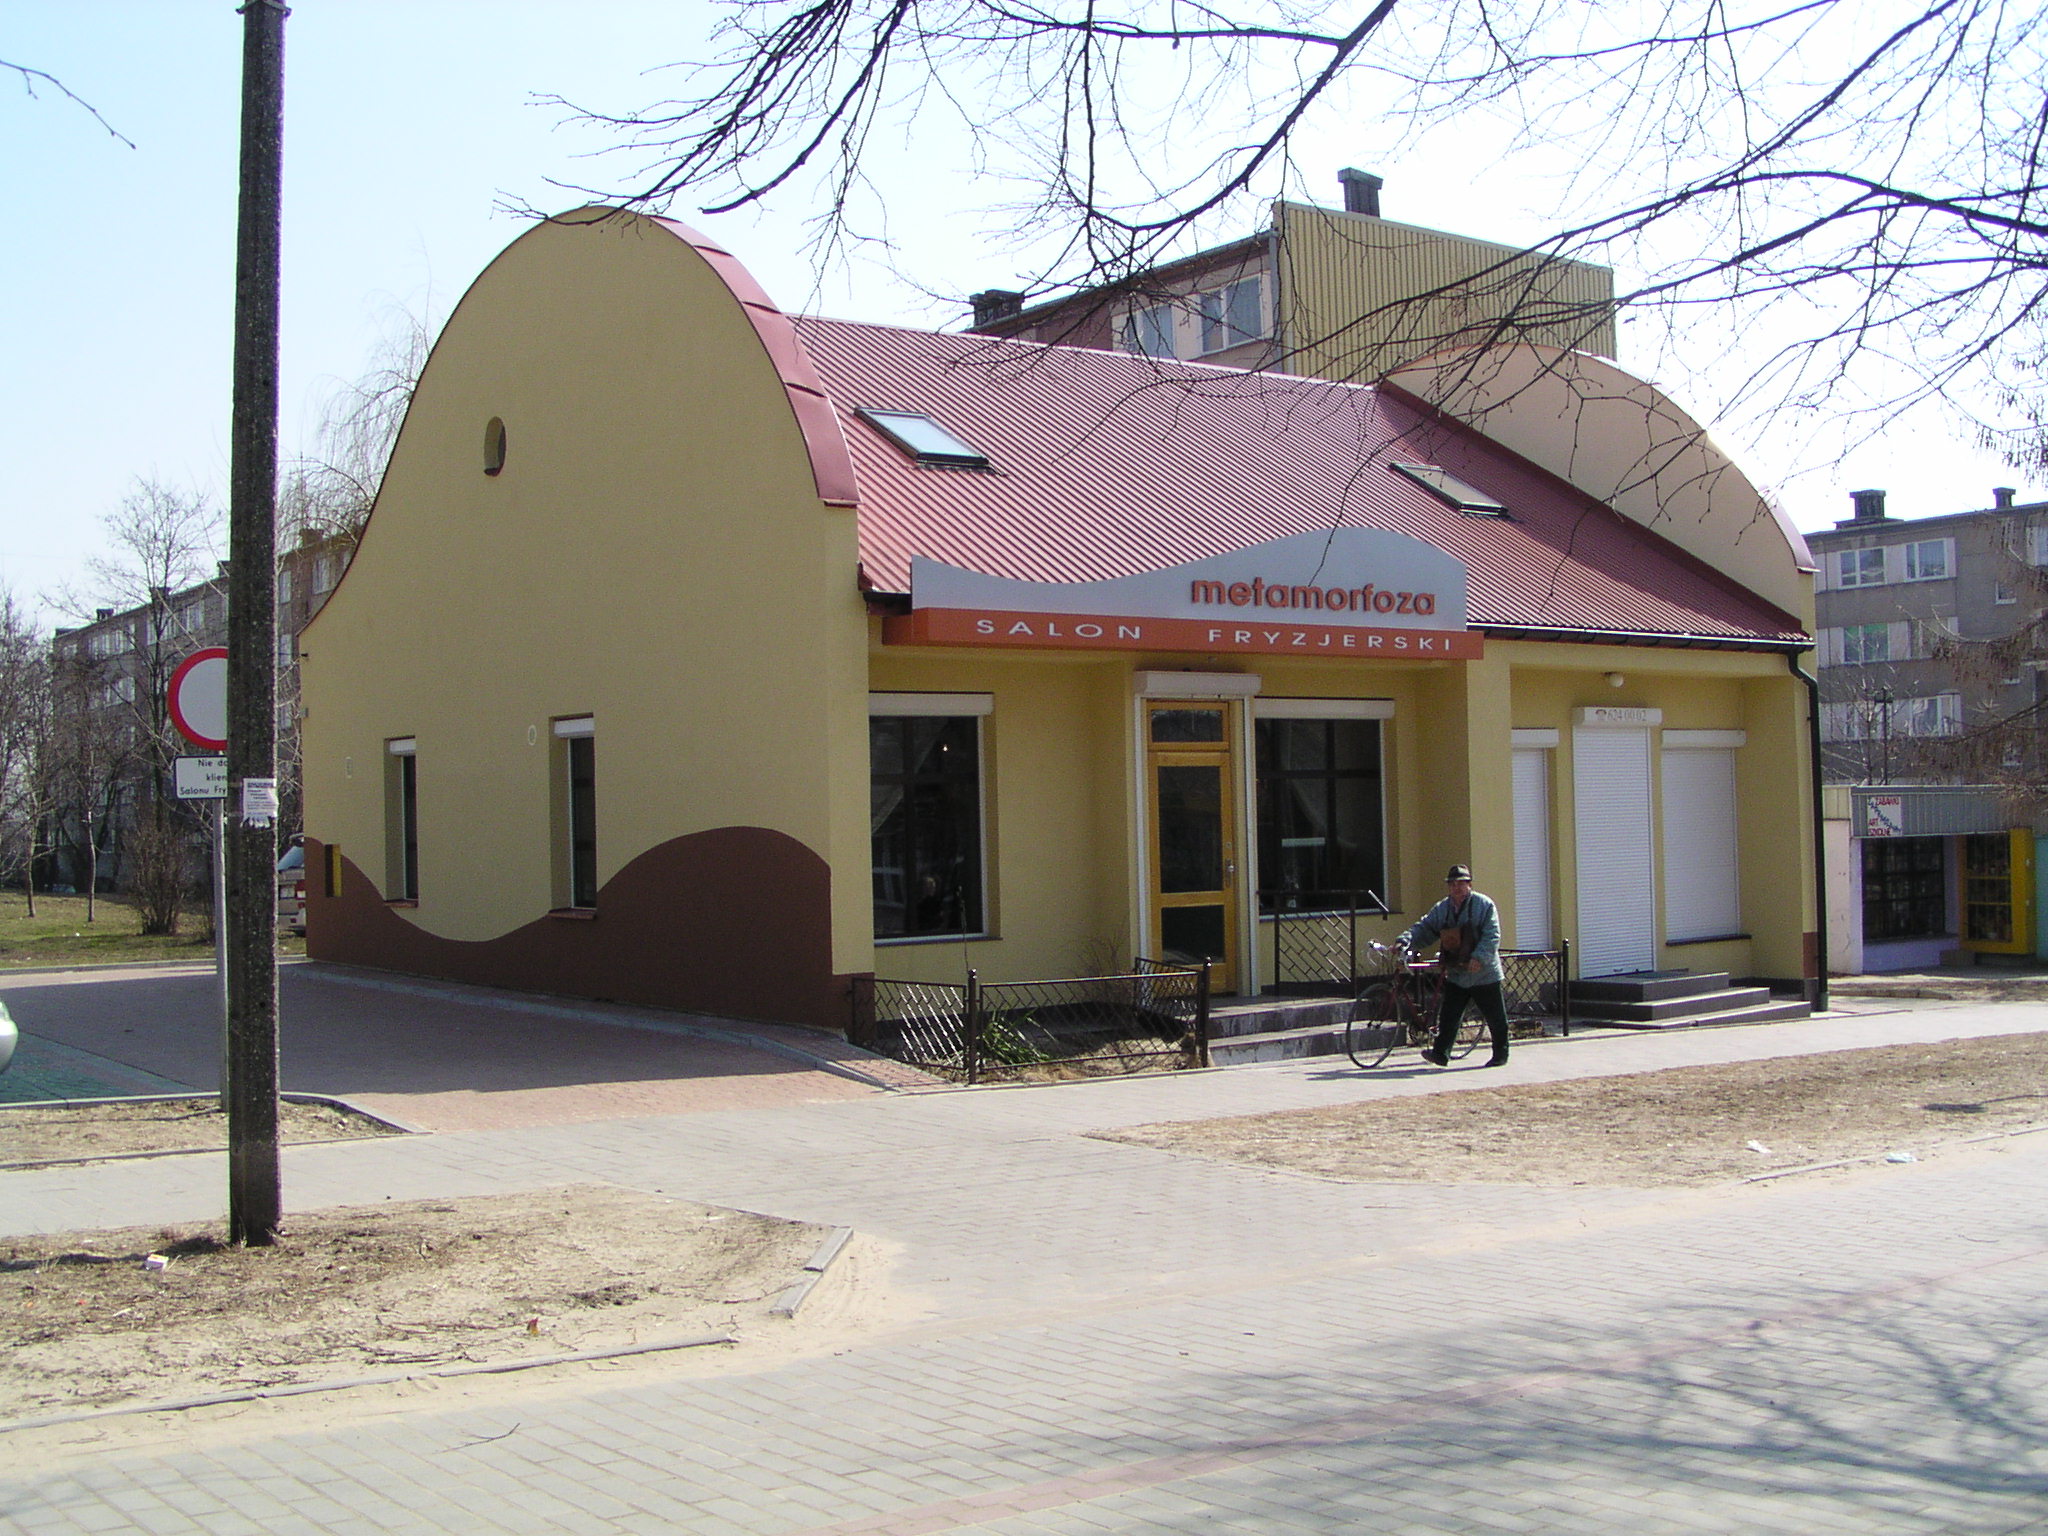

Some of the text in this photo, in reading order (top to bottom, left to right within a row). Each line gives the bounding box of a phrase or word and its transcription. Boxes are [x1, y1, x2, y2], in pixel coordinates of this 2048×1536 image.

[1191, 576, 1436, 615] metamorfoza
[976, 619, 1451, 651] SALON FRYZJERSKI
[198, 758, 213, 767] Nie
[180, 786, 210, 796] Salonu
